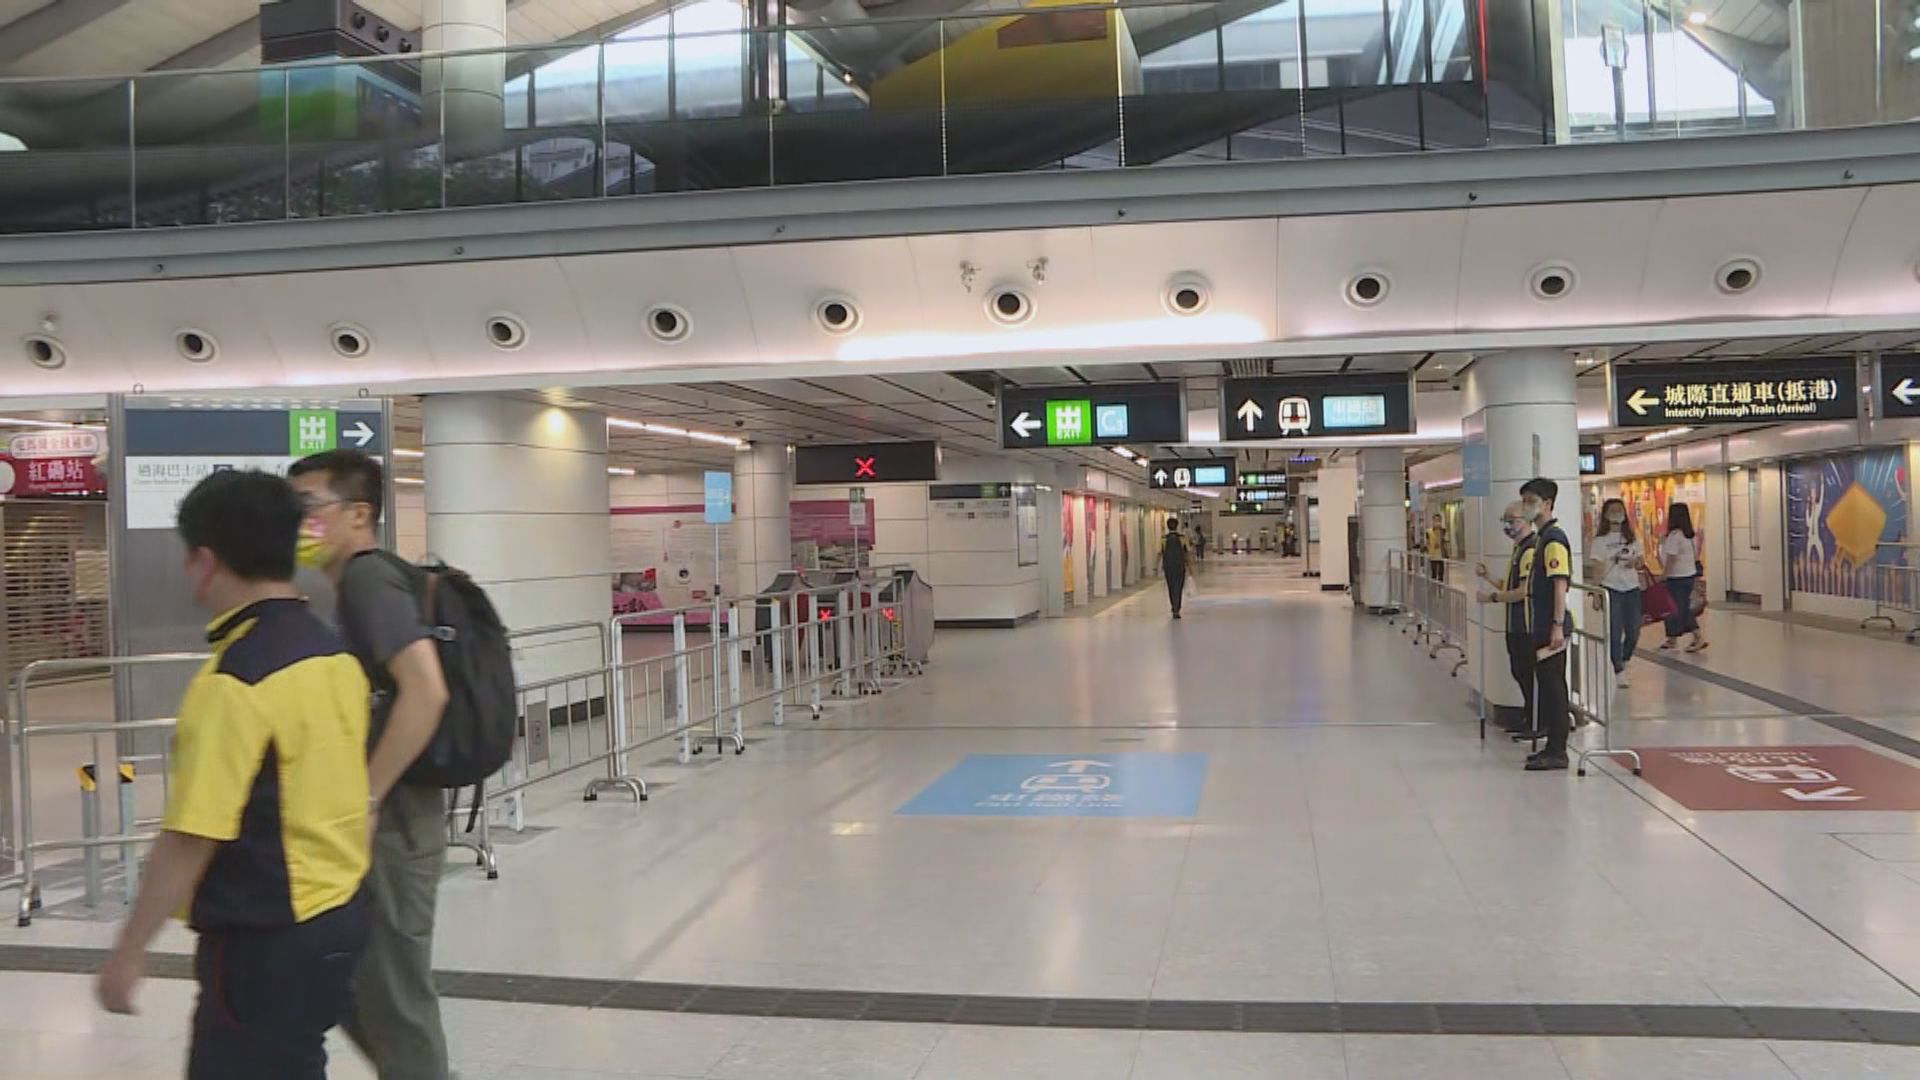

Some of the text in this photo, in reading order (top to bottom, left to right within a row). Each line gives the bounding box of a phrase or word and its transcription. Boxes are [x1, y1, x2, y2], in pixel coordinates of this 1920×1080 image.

[1664, 379, 1838, 406] 城際直通車(抵港)
[1664, 402, 1818, 418] Intercity Through Train (Arrival)
[1056, 429, 1081, 440] EXIT
[300, 439, 325, 449] EXIT
[28, 459, 84, 481] 紅磡站
